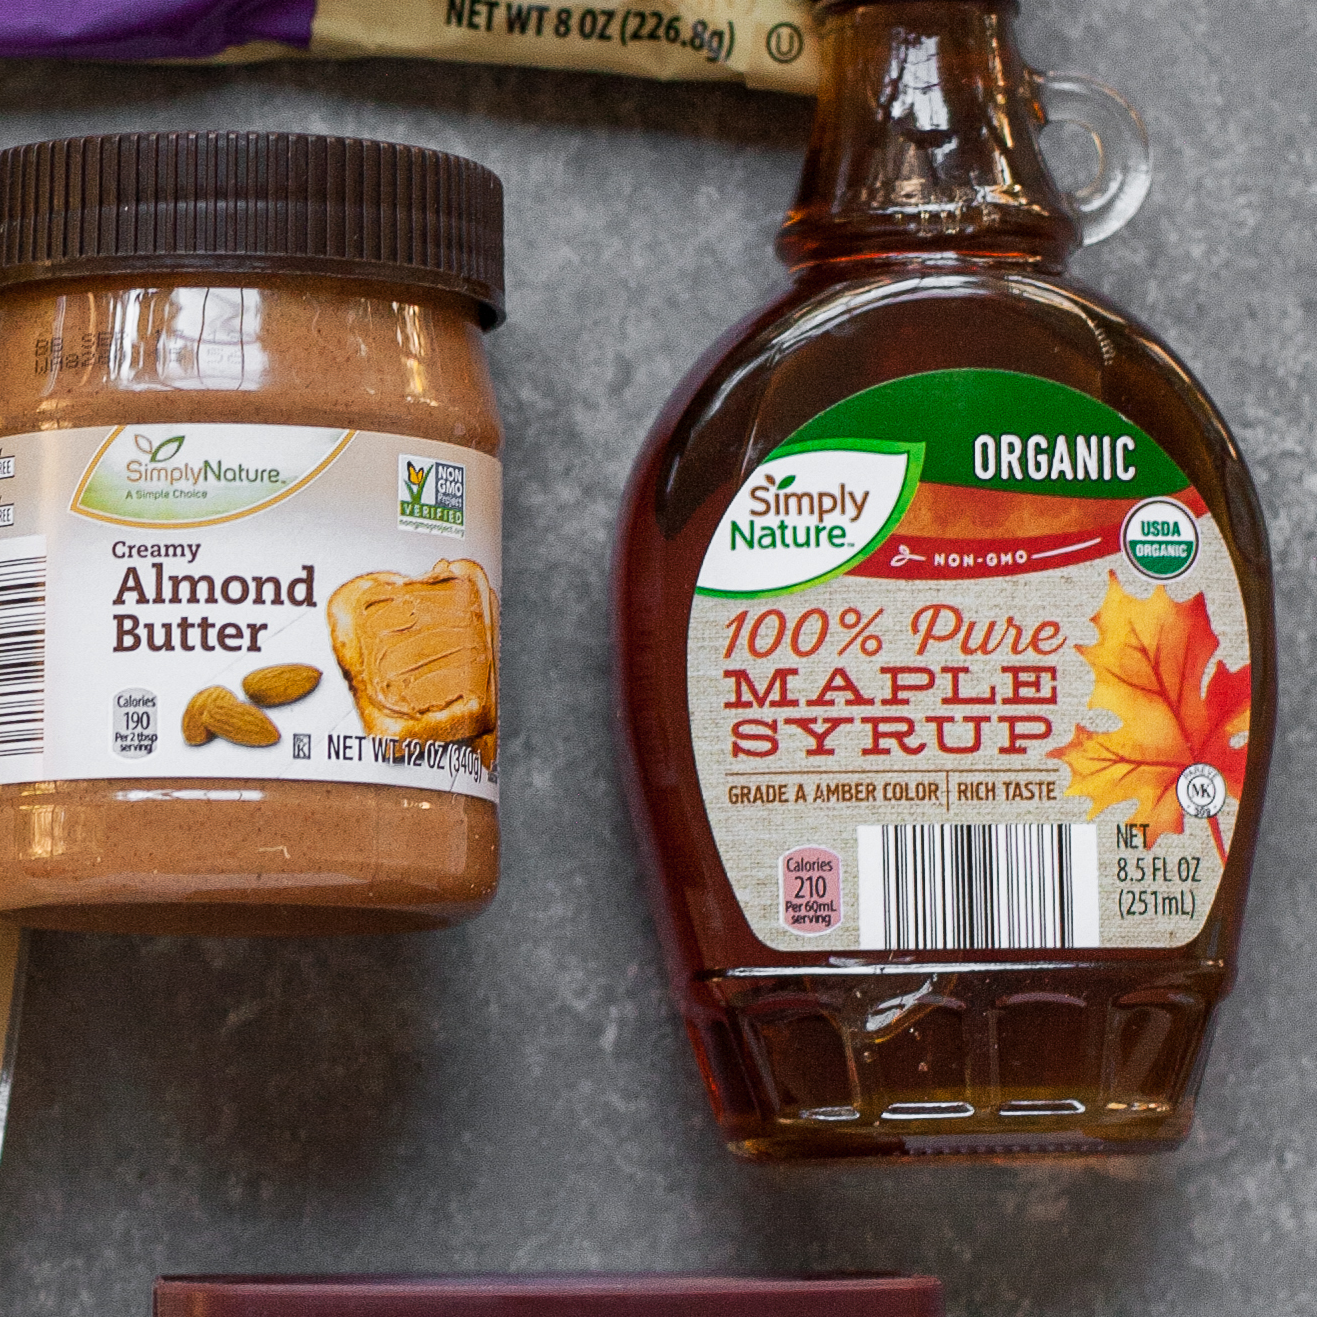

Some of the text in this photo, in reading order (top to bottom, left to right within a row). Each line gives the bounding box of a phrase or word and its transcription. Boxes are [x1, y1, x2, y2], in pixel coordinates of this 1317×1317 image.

[505, 1, 548, 36] WT
[554, 7, 571, 38] 8
[580, 10, 616, 40] OZ
[619, 8, 735, 63] (226.8g)
[973, 433, 1136, 482] ORGANIC
[126, 459, 280, 486] SimplyNature
[438, 466, 462, 482] NON
[126, 489, 207, 501] A Simple Choice
[438, 480, 462, 496] GMO
[438, 493, 462, 508] Project
[748, 483, 870, 523] Simply
[403, 503, 462, 523] VERIFIED
[730, 520, 847, 550] Nature
[1140, 520, 1181, 538] USDA
[112, 540, 201, 563] Creamy
[934, 550, 1028, 568] NON-GMO
[1136, 542, 1188, 559] ORGANIC
[112, 562, 317, 608] Almond
[113, 613, 268, 653] Butter
[723, 603, 1066, 660] 100% Pure
[723, 664, 1058, 710] MAPLE
[117, 695, 156, 708] Calories
[123, 712, 150, 729] 190
[115, 731, 158, 746] Per tbsp
[119, 742, 152, 753] serving
[731, 715, 1054, 758] SYRUP
[327, 733, 364, 762] NET
[372, 735, 399, 764] WT
[403, 740, 422, 766] 12
[426, 743, 446, 770] OZ
[447, 744, 482, 784] (340g)
[728, 780, 1058, 804] GRADE A AMBER COLOR RICH TASTE
[1116, 823, 1150, 848] NET
[786, 857, 833, 872] Calories
[1116, 857, 1202, 882] 8.5 FL OZ
[794, 875, 827, 899] 210
[786, 901, 837, 913] Per 60mL
[1117, 888, 1196, 919] (251mL)
[791, 913, 832, 927] serving
